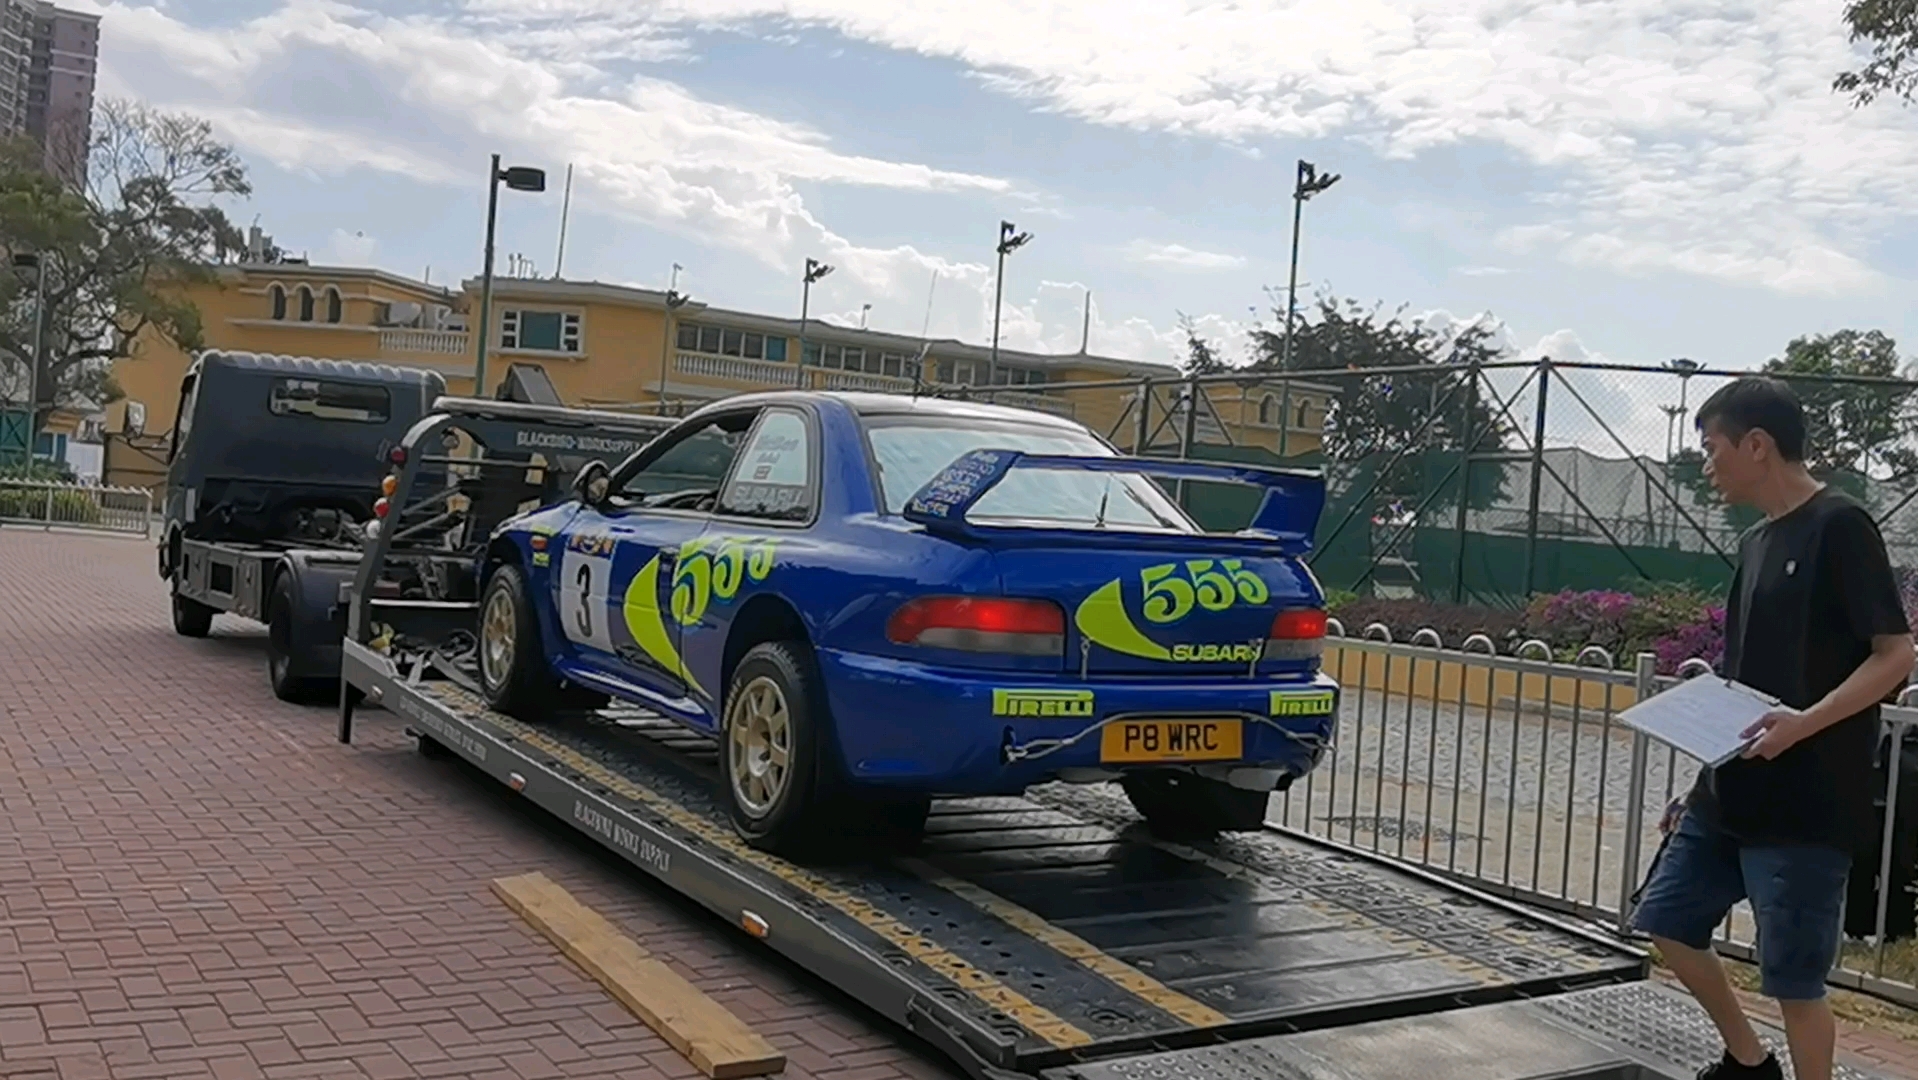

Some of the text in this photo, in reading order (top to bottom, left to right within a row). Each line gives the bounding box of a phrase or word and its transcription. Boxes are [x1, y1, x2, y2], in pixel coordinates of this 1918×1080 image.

[576, 563, 593, 638] 3
[671, 536, 780, 626] 555
[1141, 559, 1268, 623] 555
[992, 688, 1094, 716] PIRELLI
[1270, 690, 1334, 715] PIRELLI
[1124, 723, 1219, 751] P8 WRC
